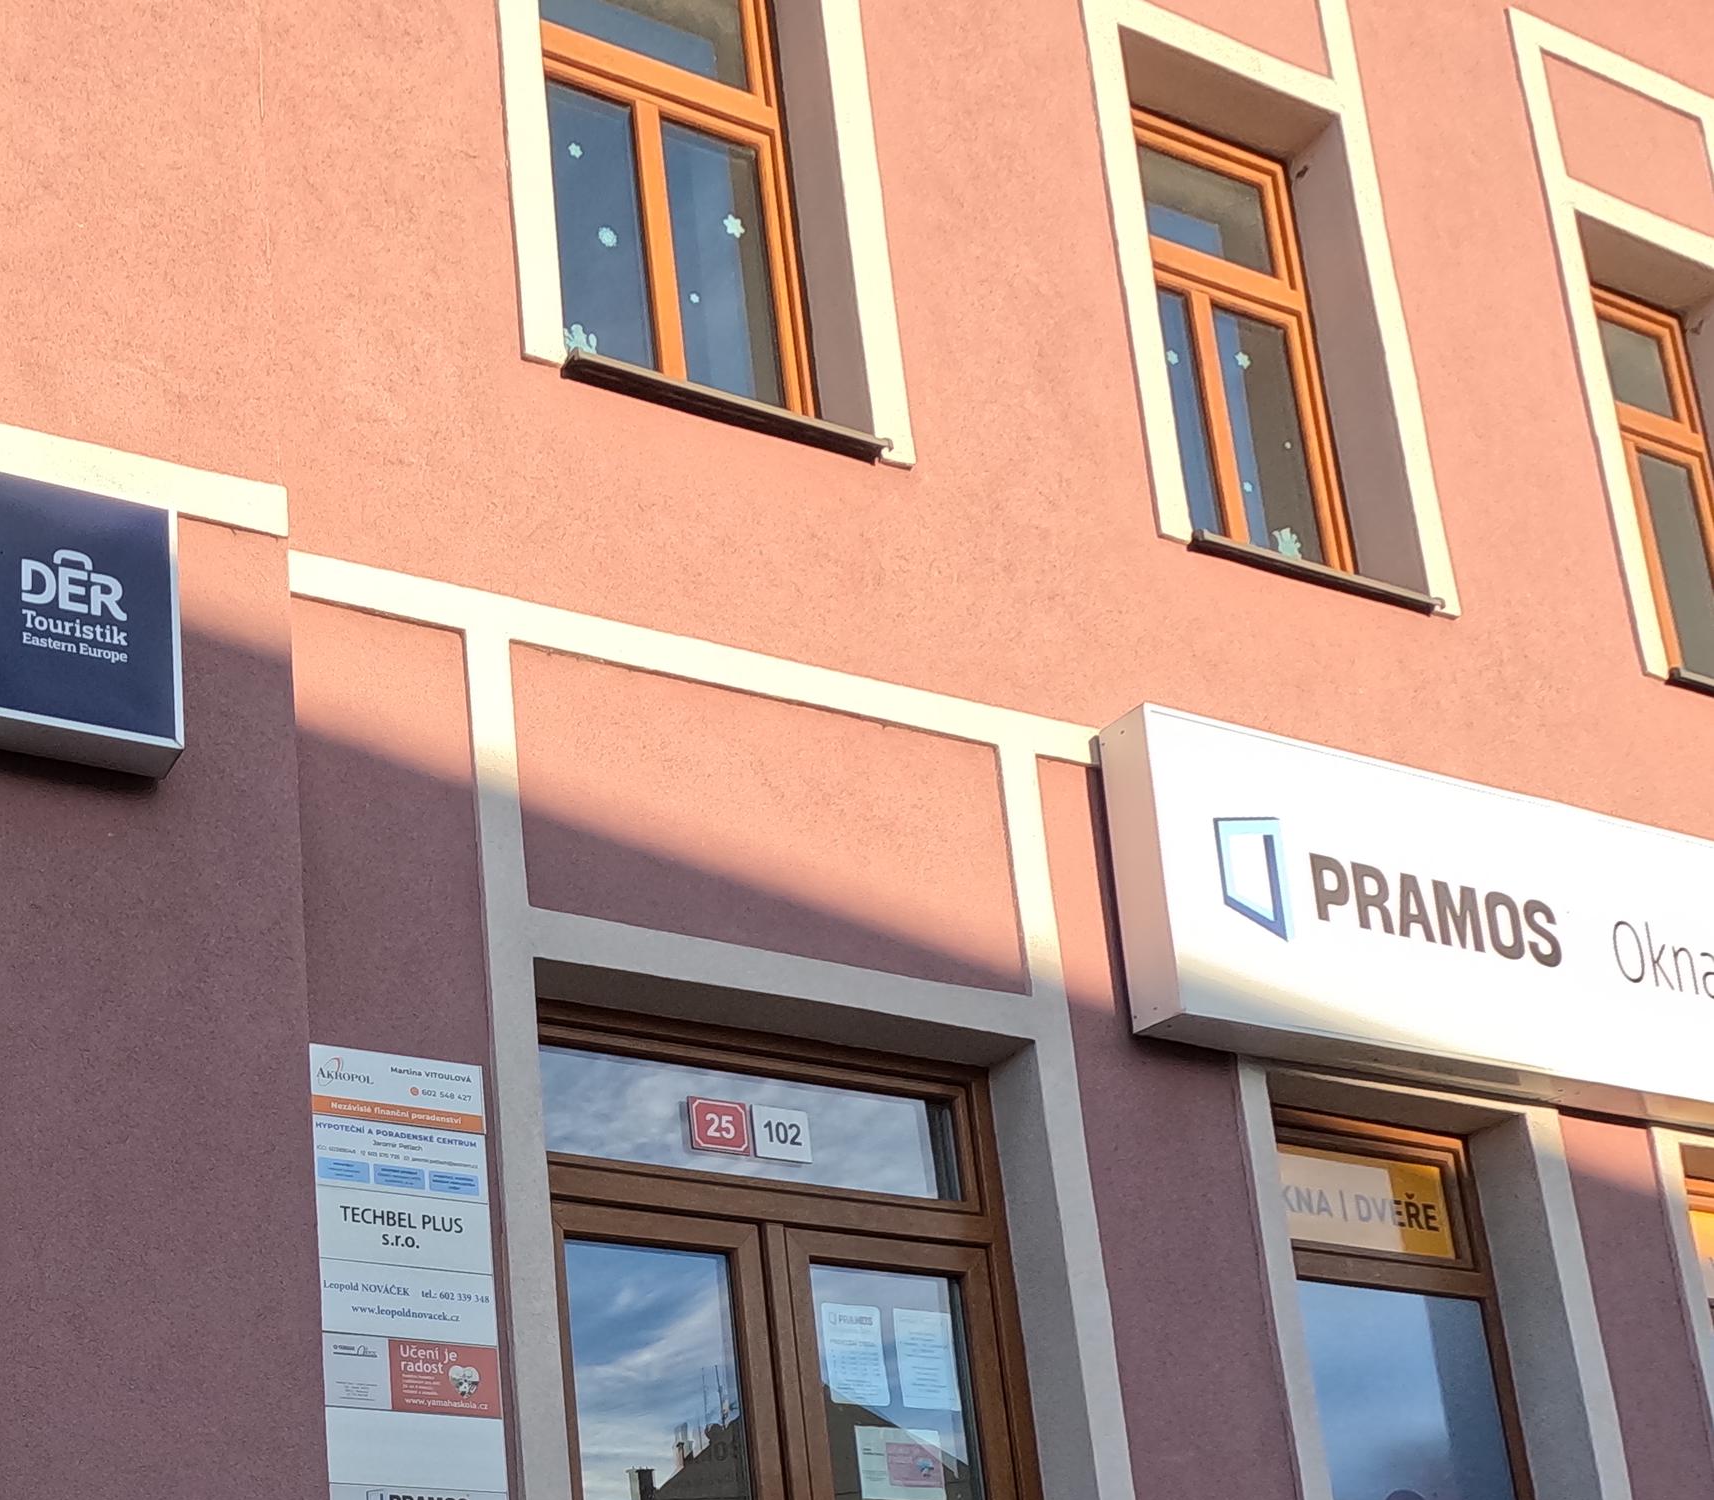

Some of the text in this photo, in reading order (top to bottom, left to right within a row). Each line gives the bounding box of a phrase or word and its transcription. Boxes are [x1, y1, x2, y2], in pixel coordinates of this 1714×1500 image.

[21, 552, 127, 622] DER
[22, 609, 128, 647] Touristik
[22, 632, 128, 664] Eastern Europe
[1309, 852, 1562, 968] PRAMOS
[390, 1066, 422, 1077] Martina
[421, 1088, 472, 1102] 602 548 427
[316, 1121, 365, 1134] HYPOTEČNÍ
[376, 1129, 434, 1143] PORADENSKÉ
[436, 1136, 477, 1148] CENTRUM
[705, 1113, 802, 1146] 25 102
[339, 1205, 463, 1234] TECHBEL PLUS
[1281, 1184, 1440, 1232] KNA DVEŘE
[381, 1233, 420, 1249] s.r.o.
[323, 1279, 359, 1292] Leopold
[361, 1282, 410, 1297] NOVÁČEK
[439, 1291, 455, 1301] 602
[458, 1292, 472, 1302] 339
[474, 1294, 490, 1304] 348
[351, 1304, 460, 1322] www.leopoldnovacek.cz
[399, 1344, 457, 1364] Učení je
[400, 1360, 444, 1374] radost
